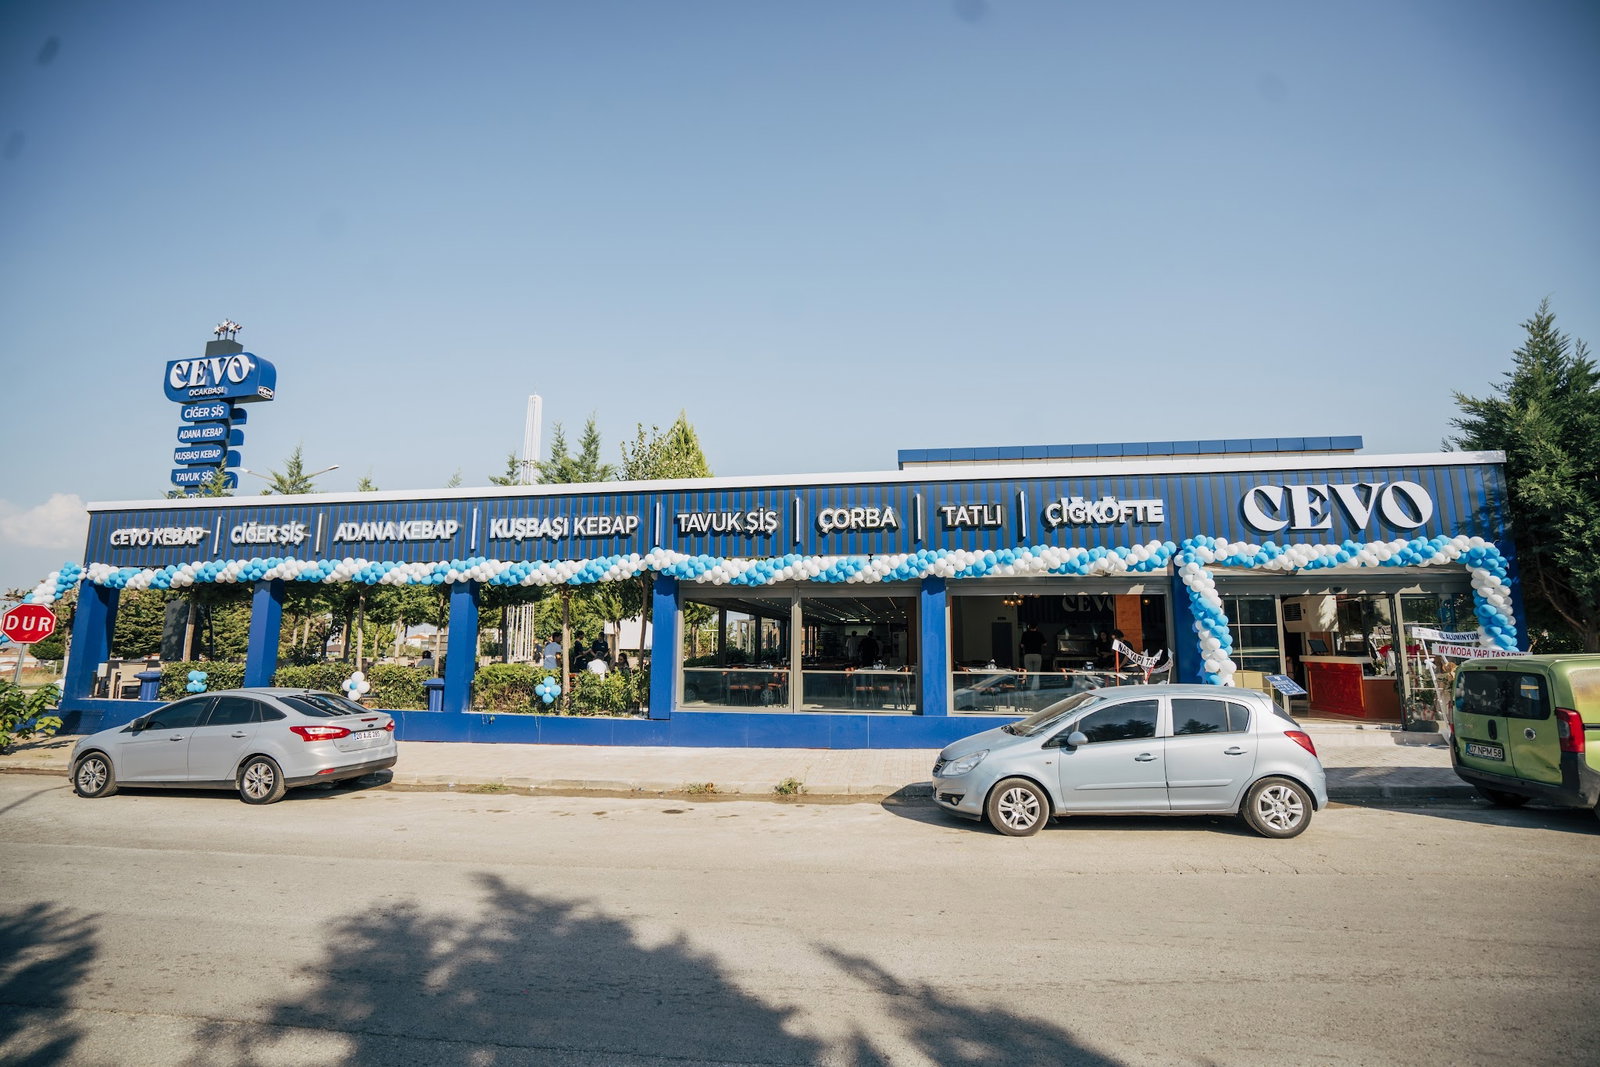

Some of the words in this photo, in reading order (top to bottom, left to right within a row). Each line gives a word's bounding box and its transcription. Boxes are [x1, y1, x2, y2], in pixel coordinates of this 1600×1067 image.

[170, 354, 249, 388] CEVO
[184, 406, 209, 418] CİĞER
[211, 404, 224, 417] ŞİŞ
[179, 430, 200, 439] ADANA
[202, 428, 223, 438] KEBAP
[174, 450, 199, 461] KUŞBAŞI
[200, 449, 220, 458] KEBAP
[176, 472, 200, 482] TAVUK
[941, 504, 1002, 526] TATLI
[1243, 481, 1433, 531] CEVO
[333, 521, 396, 542] ADANA
[399, 519, 459, 541] KEBAP
[490, 516, 569, 541] KUŞBAŞI
[573, 515, 639, 536] KEBAP
[677, 512, 741, 533] TAVUK
[746, 508, 777, 534] ŞİŞ
[818, 507, 897, 533] ÇORBA
[110, 528, 150, 546] CEVO
[152, 527, 204, 546] KEBAP
[230, 521, 277, 544] CİĞER
[278, 520, 305, 545] ŞİŞ
[5, 615, 52, 631] DUR
[1438, 645, 1449, 654] MY
[1450, 646, 1472, 657] MODA
[1473, 649, 1490, 658] YAPI
